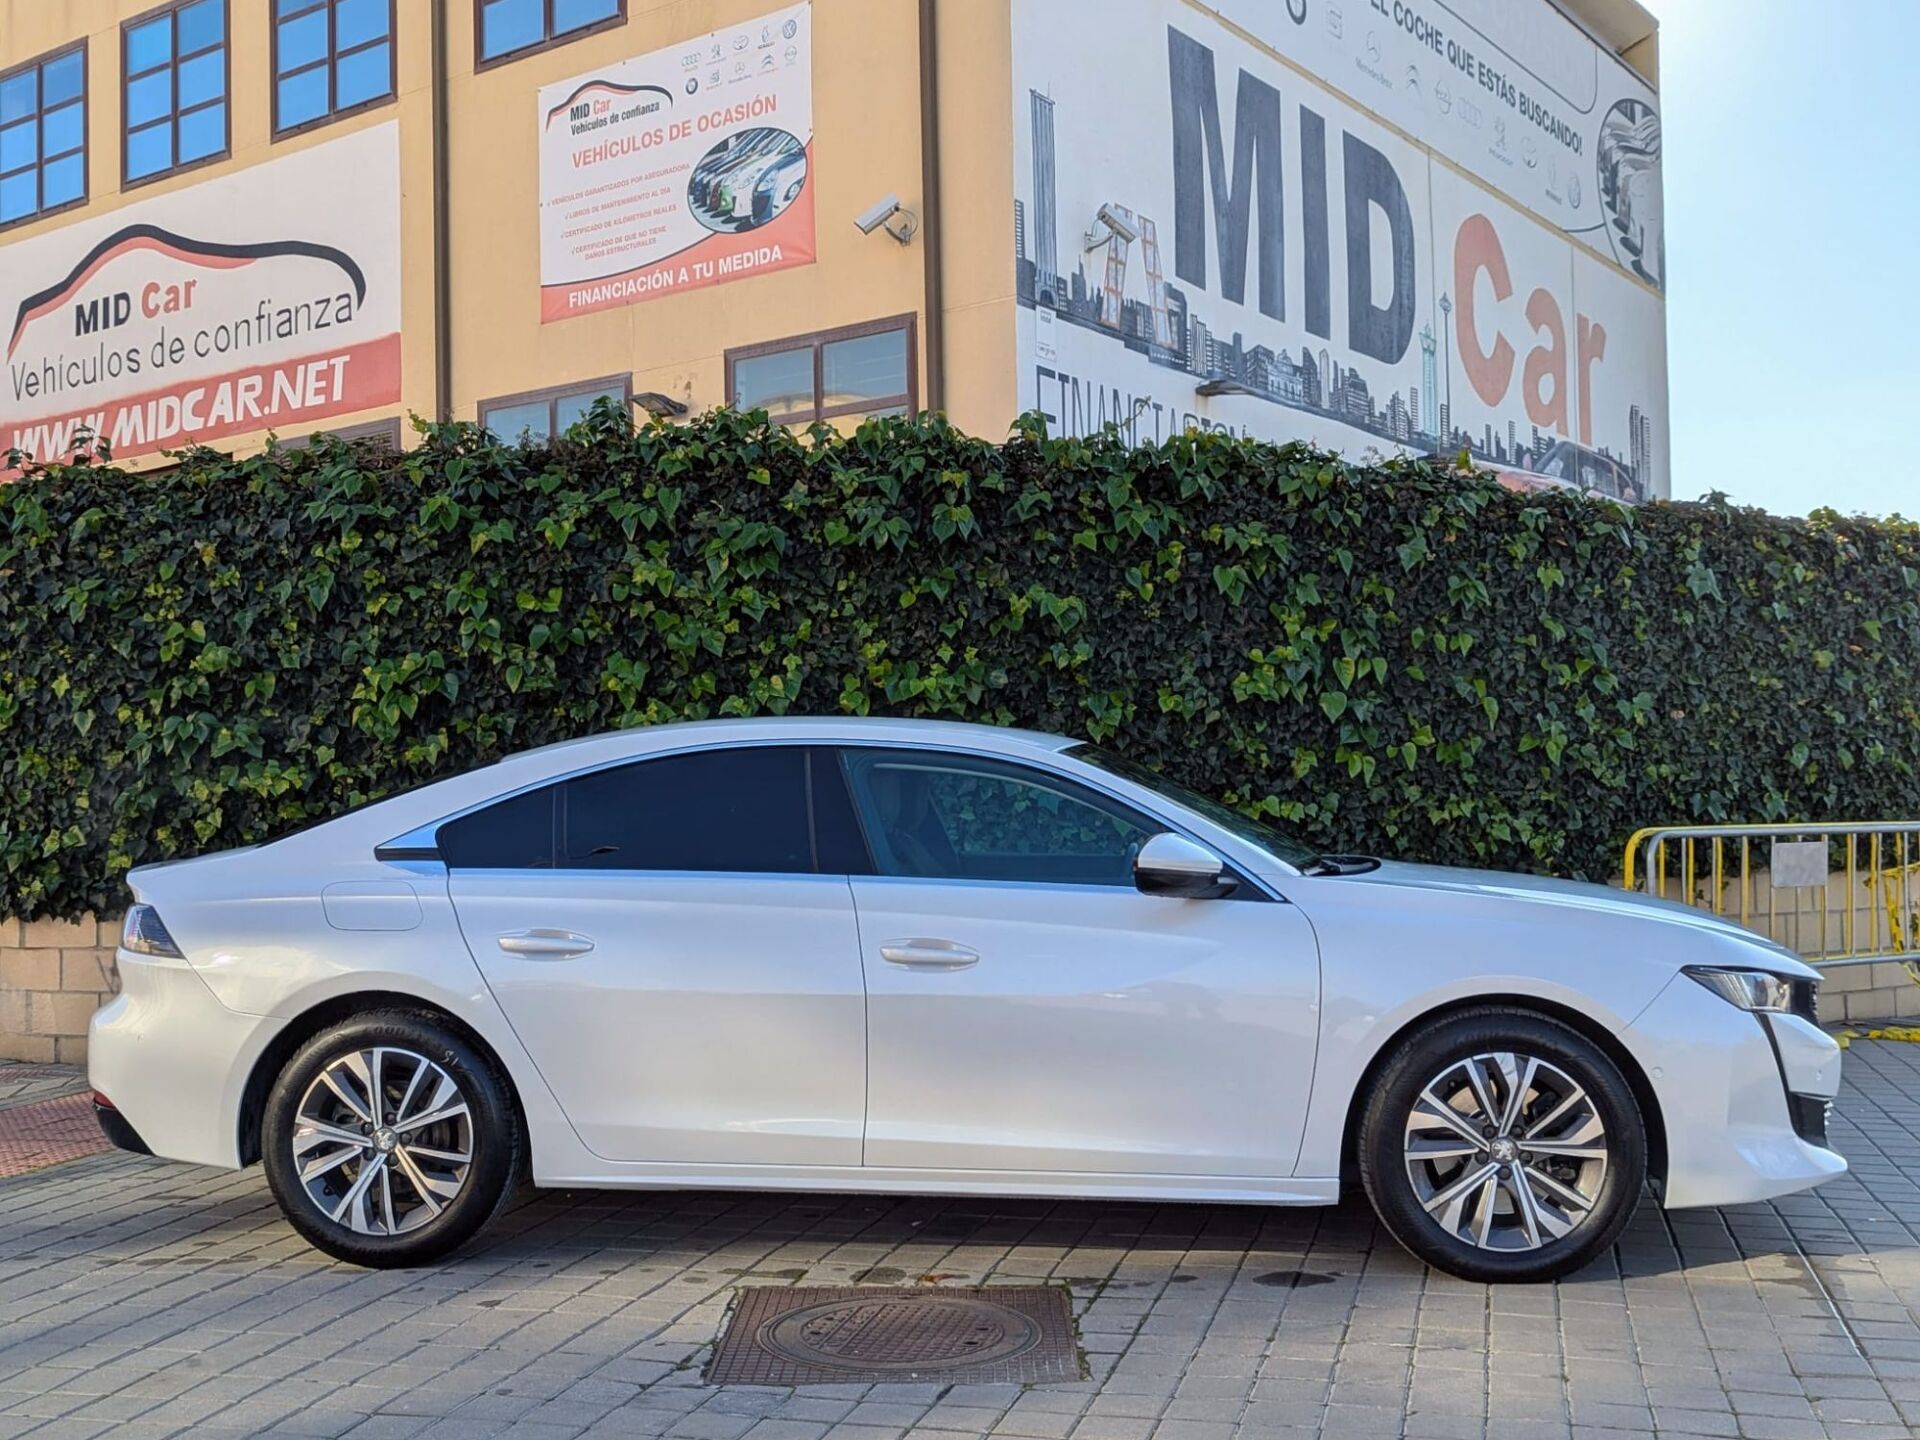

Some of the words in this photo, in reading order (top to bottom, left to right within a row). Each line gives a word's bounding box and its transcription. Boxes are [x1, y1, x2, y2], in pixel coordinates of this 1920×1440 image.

[570, 103, 590, 122] MID
[593, 99, 611, 115] Car
[610, 112, 619, 124] de
[621, 101, 660, 121] confianza
[1394, 0, 1443, 55] COCHE
[1447, 40, 1475, 78] QUE
[1478, 61, 1516, 108] ESTÁS
[1519, 92, 1583, 156] BUSCANDO!
[572, 129, 664, 168] VEHÍCULOS
[669, 120, 692, 141] DE
[697, 94, 777, 133] OCASIÓN
[1167, 24, 1416, 365] MID
[1453, 213, 1607, 446] Car
[75, 292, 131, 336] MID
[142, 279, 198, 318] Car
[569, 269, 674, 308] FINANCIACIÓN
[678, 269, 689, 284] A
[692, 260, 714, 279] TU
[718, 245, 783, 276] MEDIDA
[12, 342, 141, 401] Vehículos
[151, 326, 184, 368] de
[194, 293, 353, 358] confianza
[13, 355, 351, 463] WWW.MIDCAR.NET
